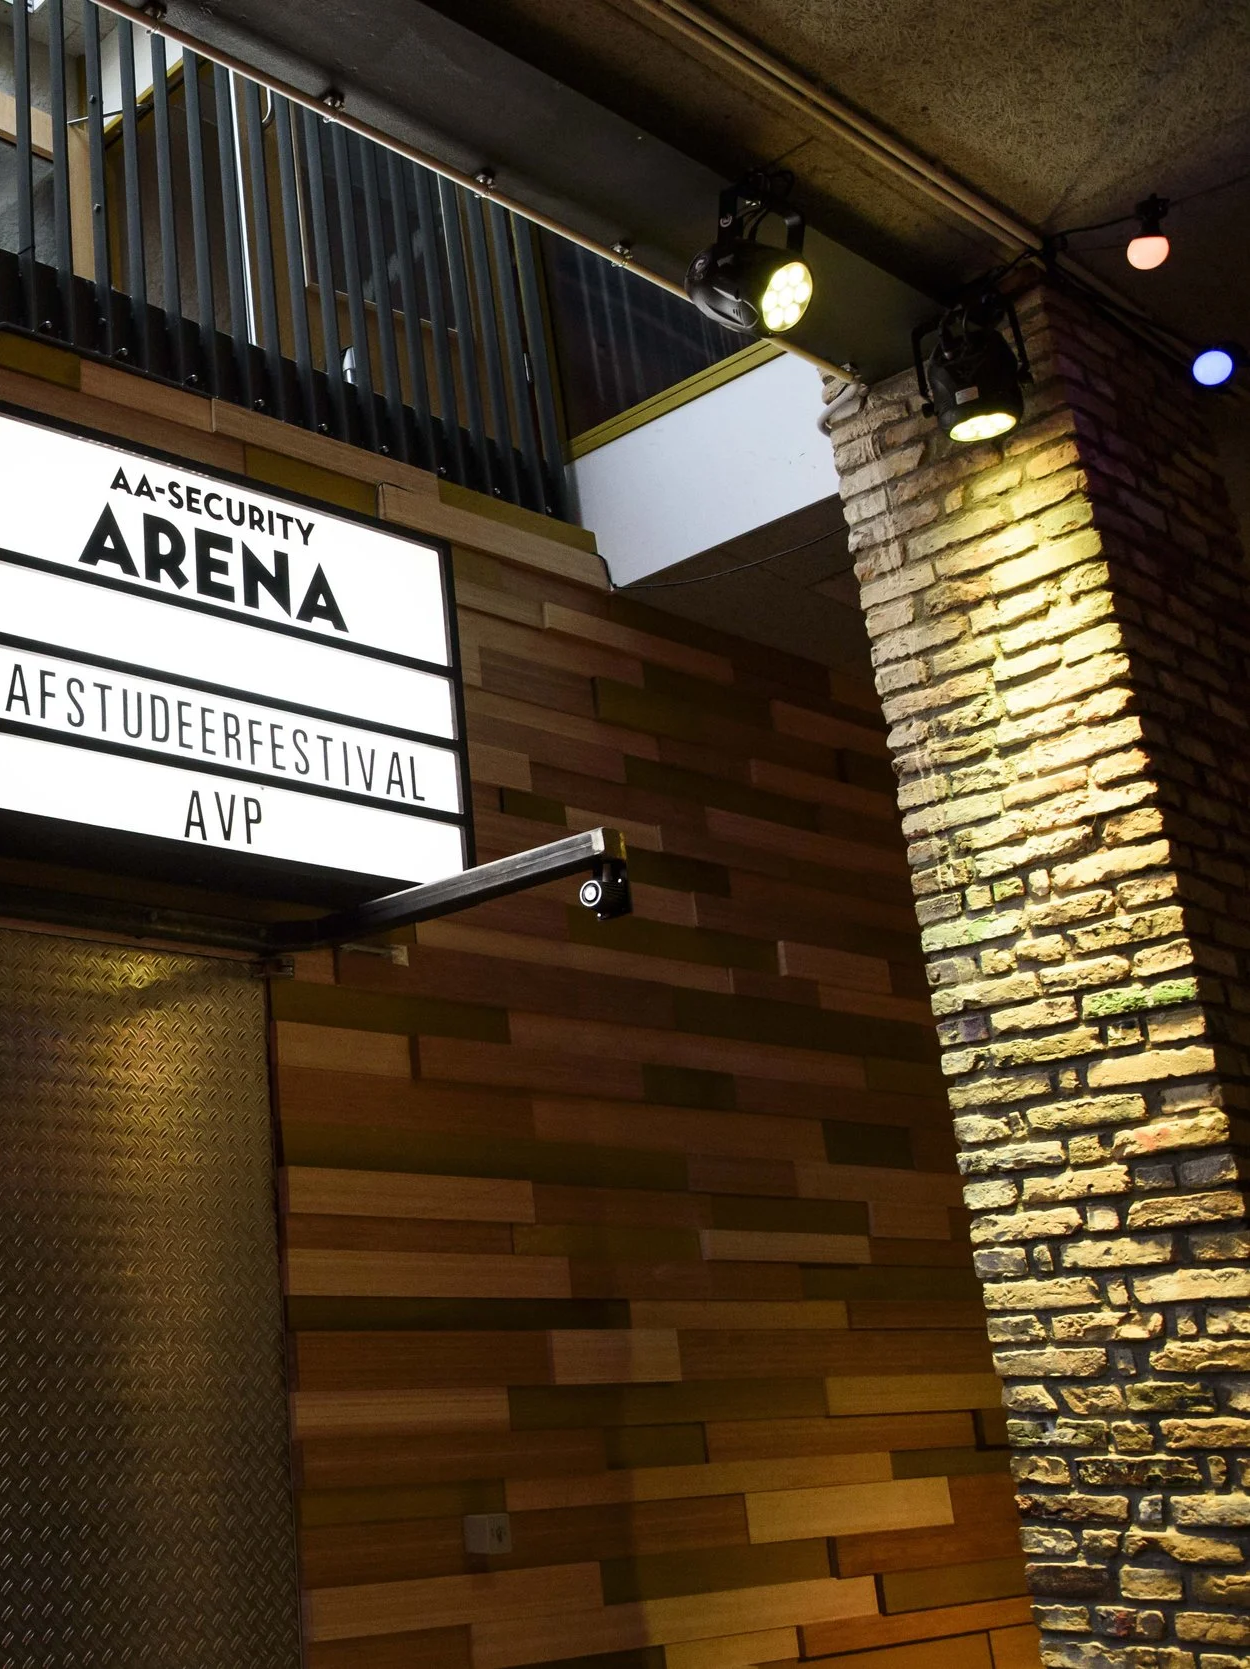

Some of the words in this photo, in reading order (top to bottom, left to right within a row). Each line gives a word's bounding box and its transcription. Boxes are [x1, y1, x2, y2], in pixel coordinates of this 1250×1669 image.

[110, 466, 315, 546] AA-SECURITY
[78, 502, 349, 633] ARENA
[5, 663, 426, 801] AFSTUDEERFESTIVAL
[184, 790, 263, 845] AVP
